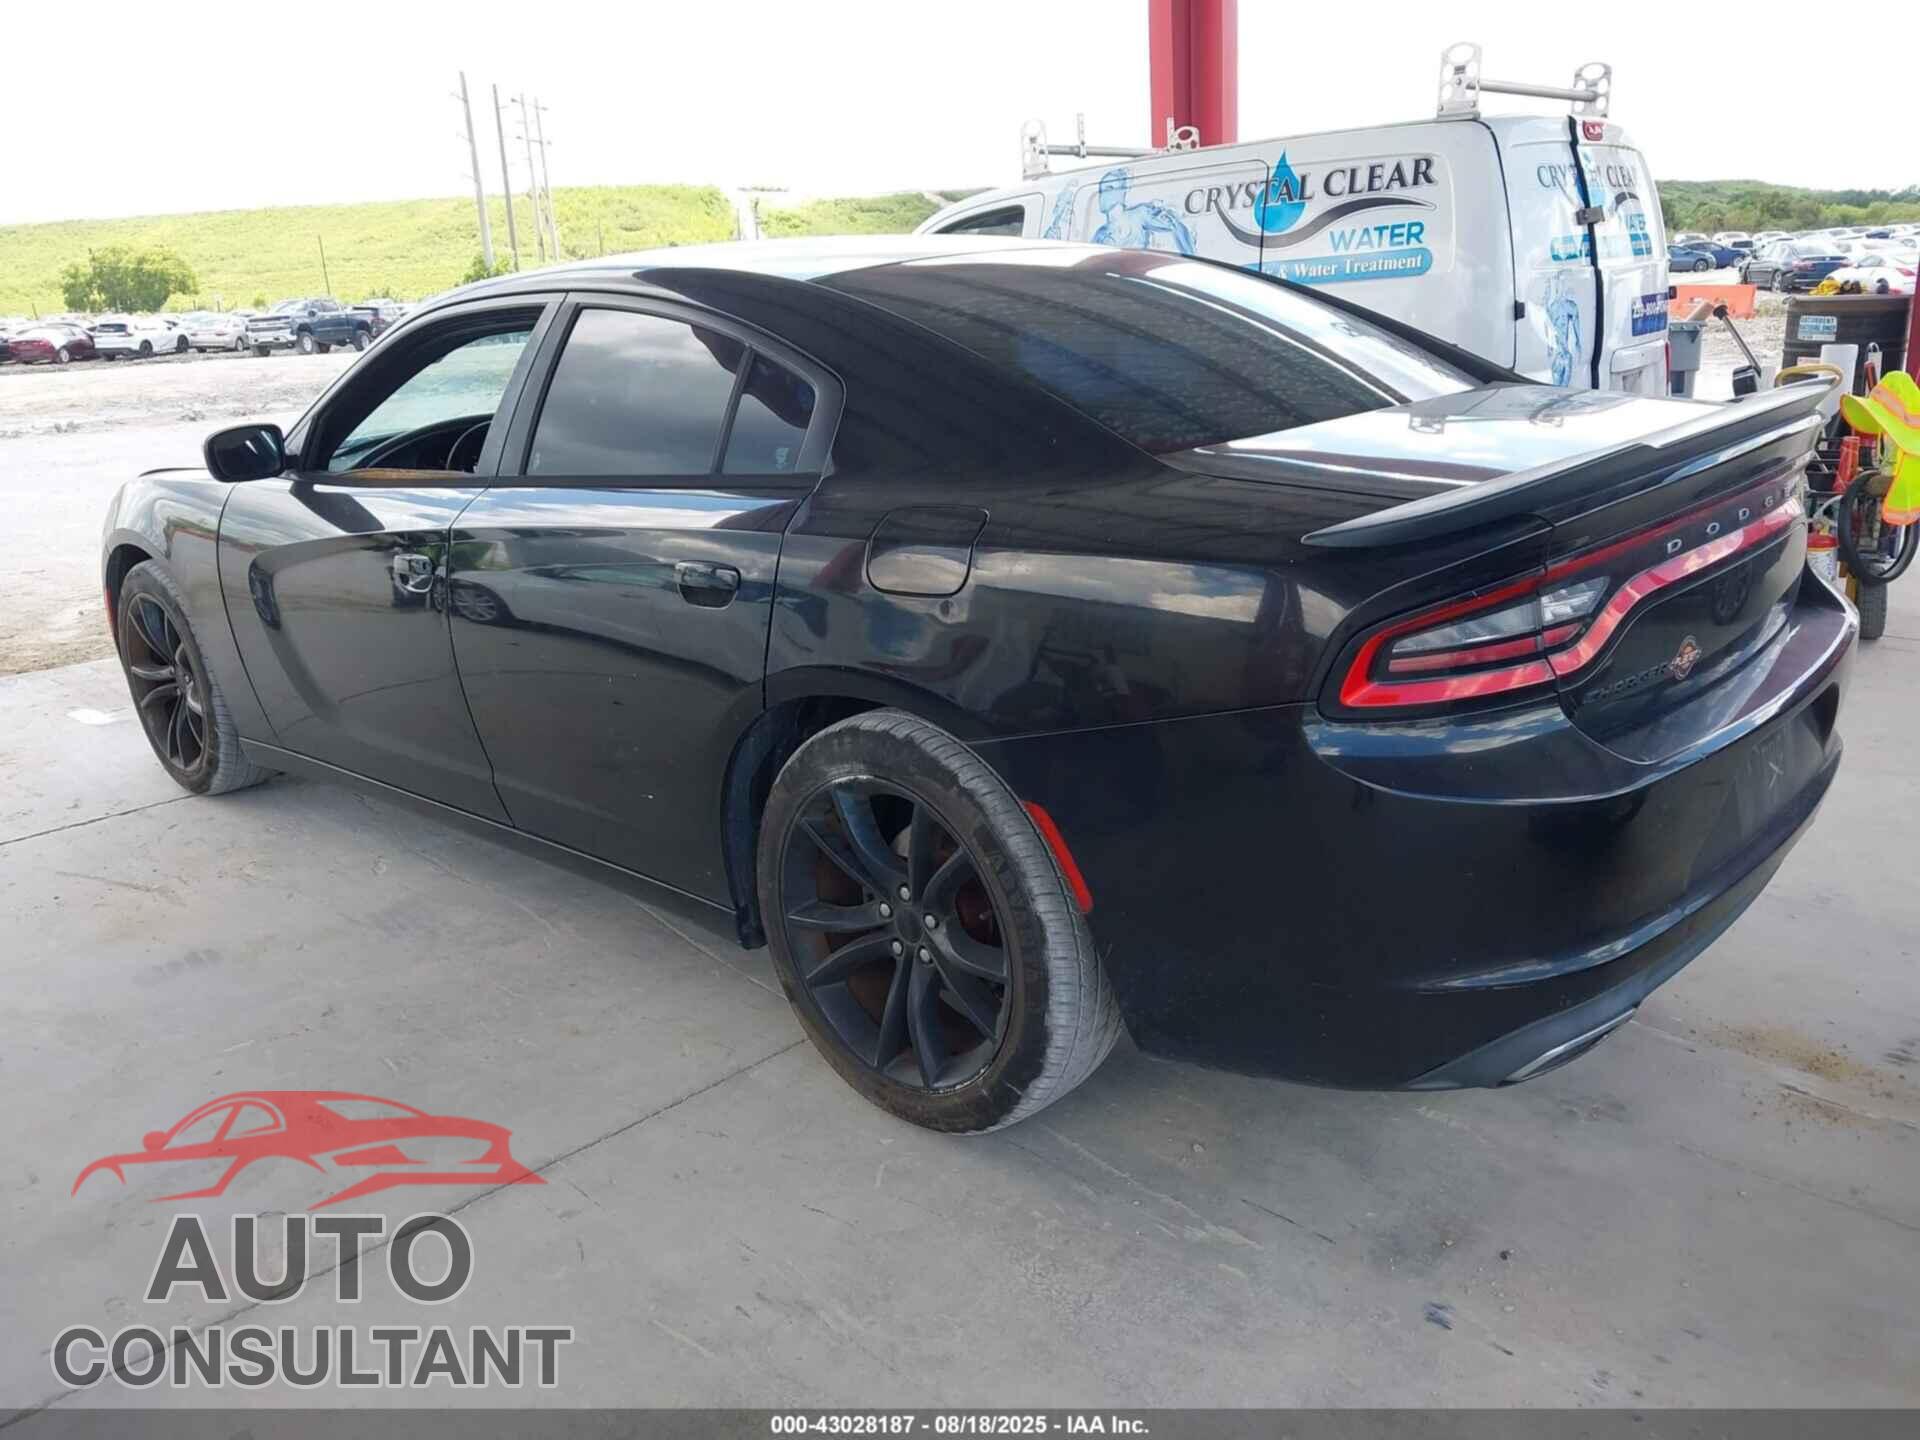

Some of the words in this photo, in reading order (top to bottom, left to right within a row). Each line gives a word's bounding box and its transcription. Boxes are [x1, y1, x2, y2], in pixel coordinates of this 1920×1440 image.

[1184, 173, 1313, 215] CRYSTAL
[1323, 157, 1436, 197] CLEAR
[1329, 220, 1425, 252] WATER
[1294, 262, 1338, 278] Water
[1344, 253, 1423, 275] Treatment
